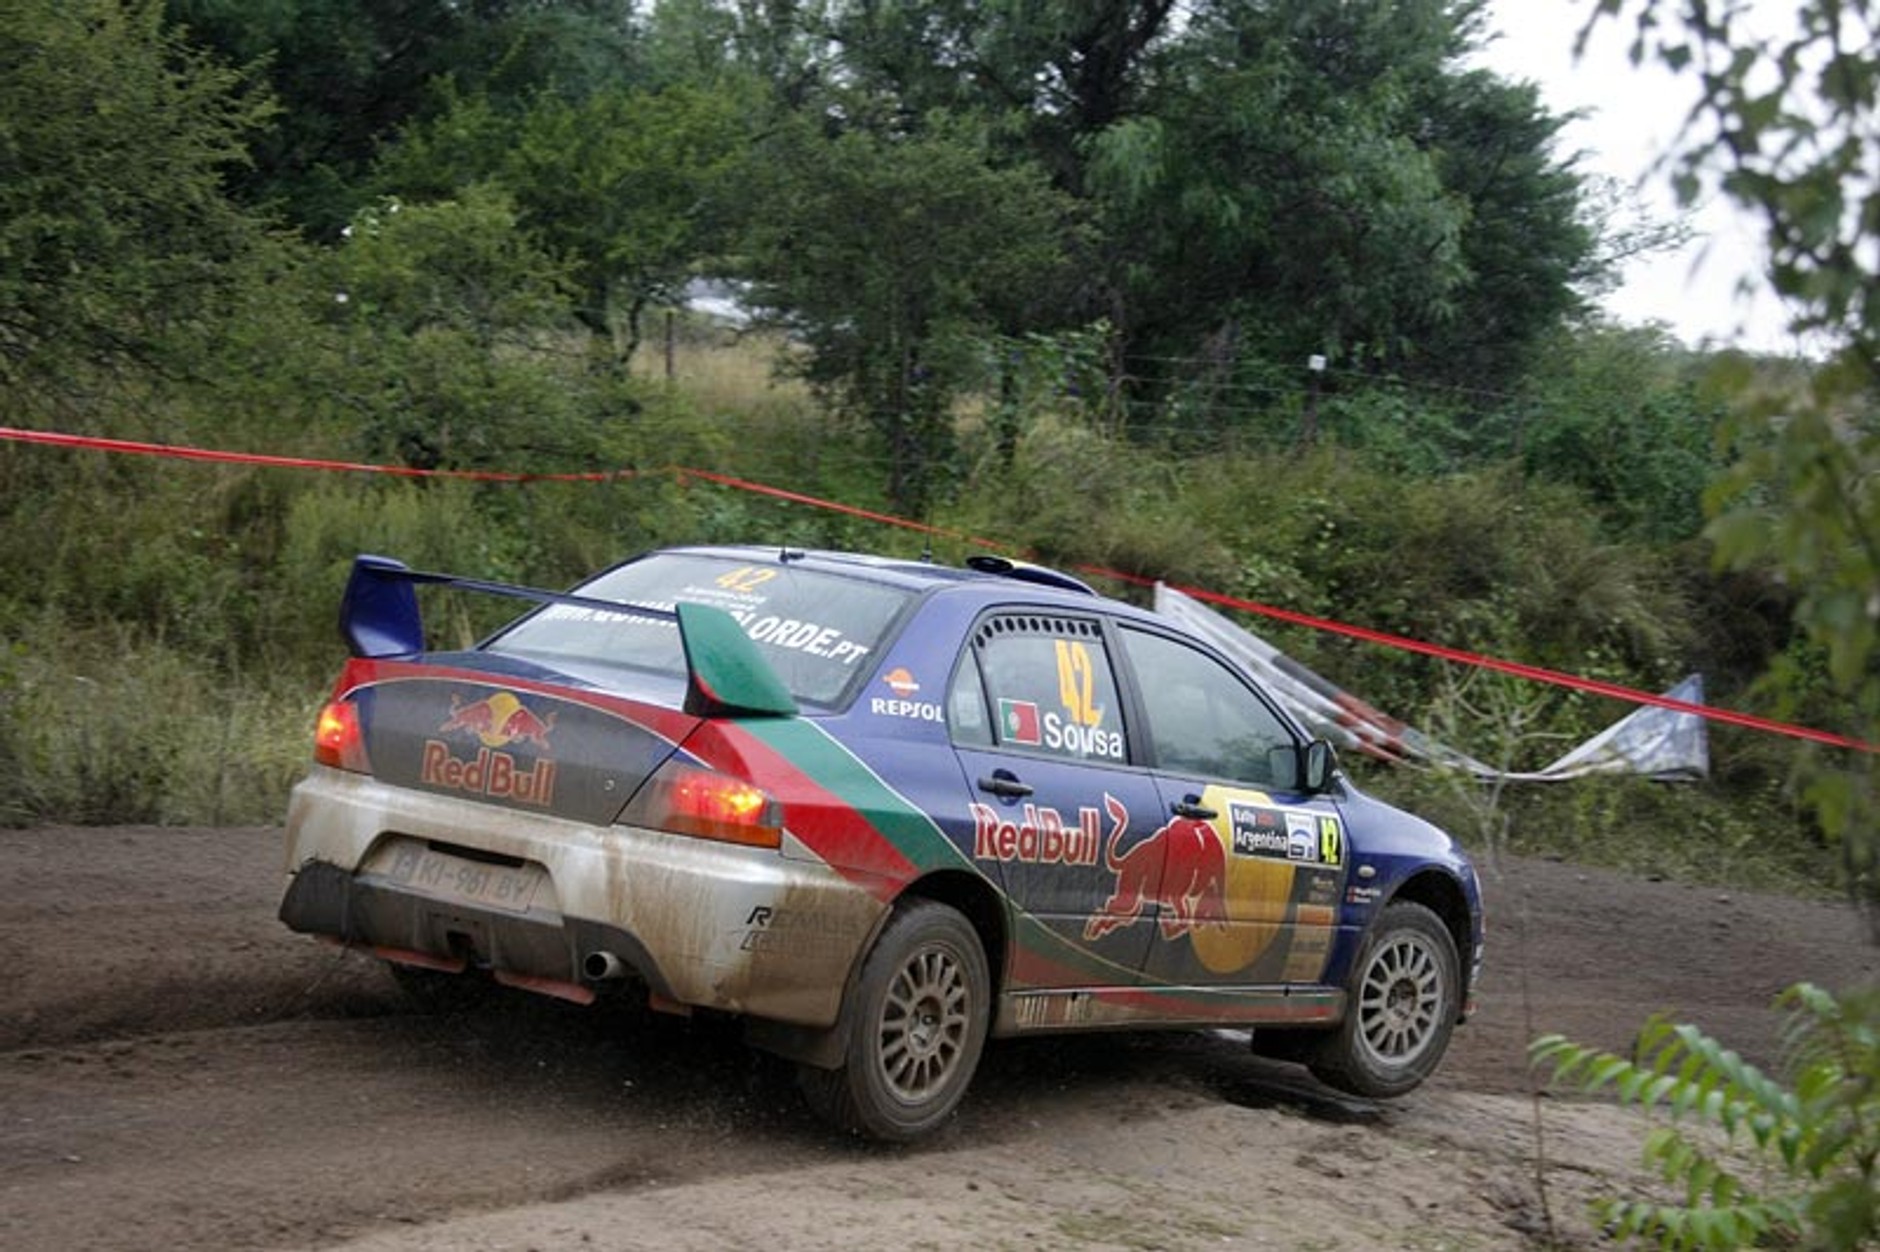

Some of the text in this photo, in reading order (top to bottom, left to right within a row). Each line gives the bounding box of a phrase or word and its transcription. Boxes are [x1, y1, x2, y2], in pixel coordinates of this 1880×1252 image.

[715, 566, 777, 593] 42
[1055, 639, 1104, 725] 42
[871, 697, 945, 723] REPSOL
[1043, 712, 1122, 758] Sousa
[422, 739, 556, 807] Red Bull
[968, 803, 1100, 865] Red Bull
[1236, 826, 1288, 851] Argentina
[1320, 816, 1338, 864] 42
